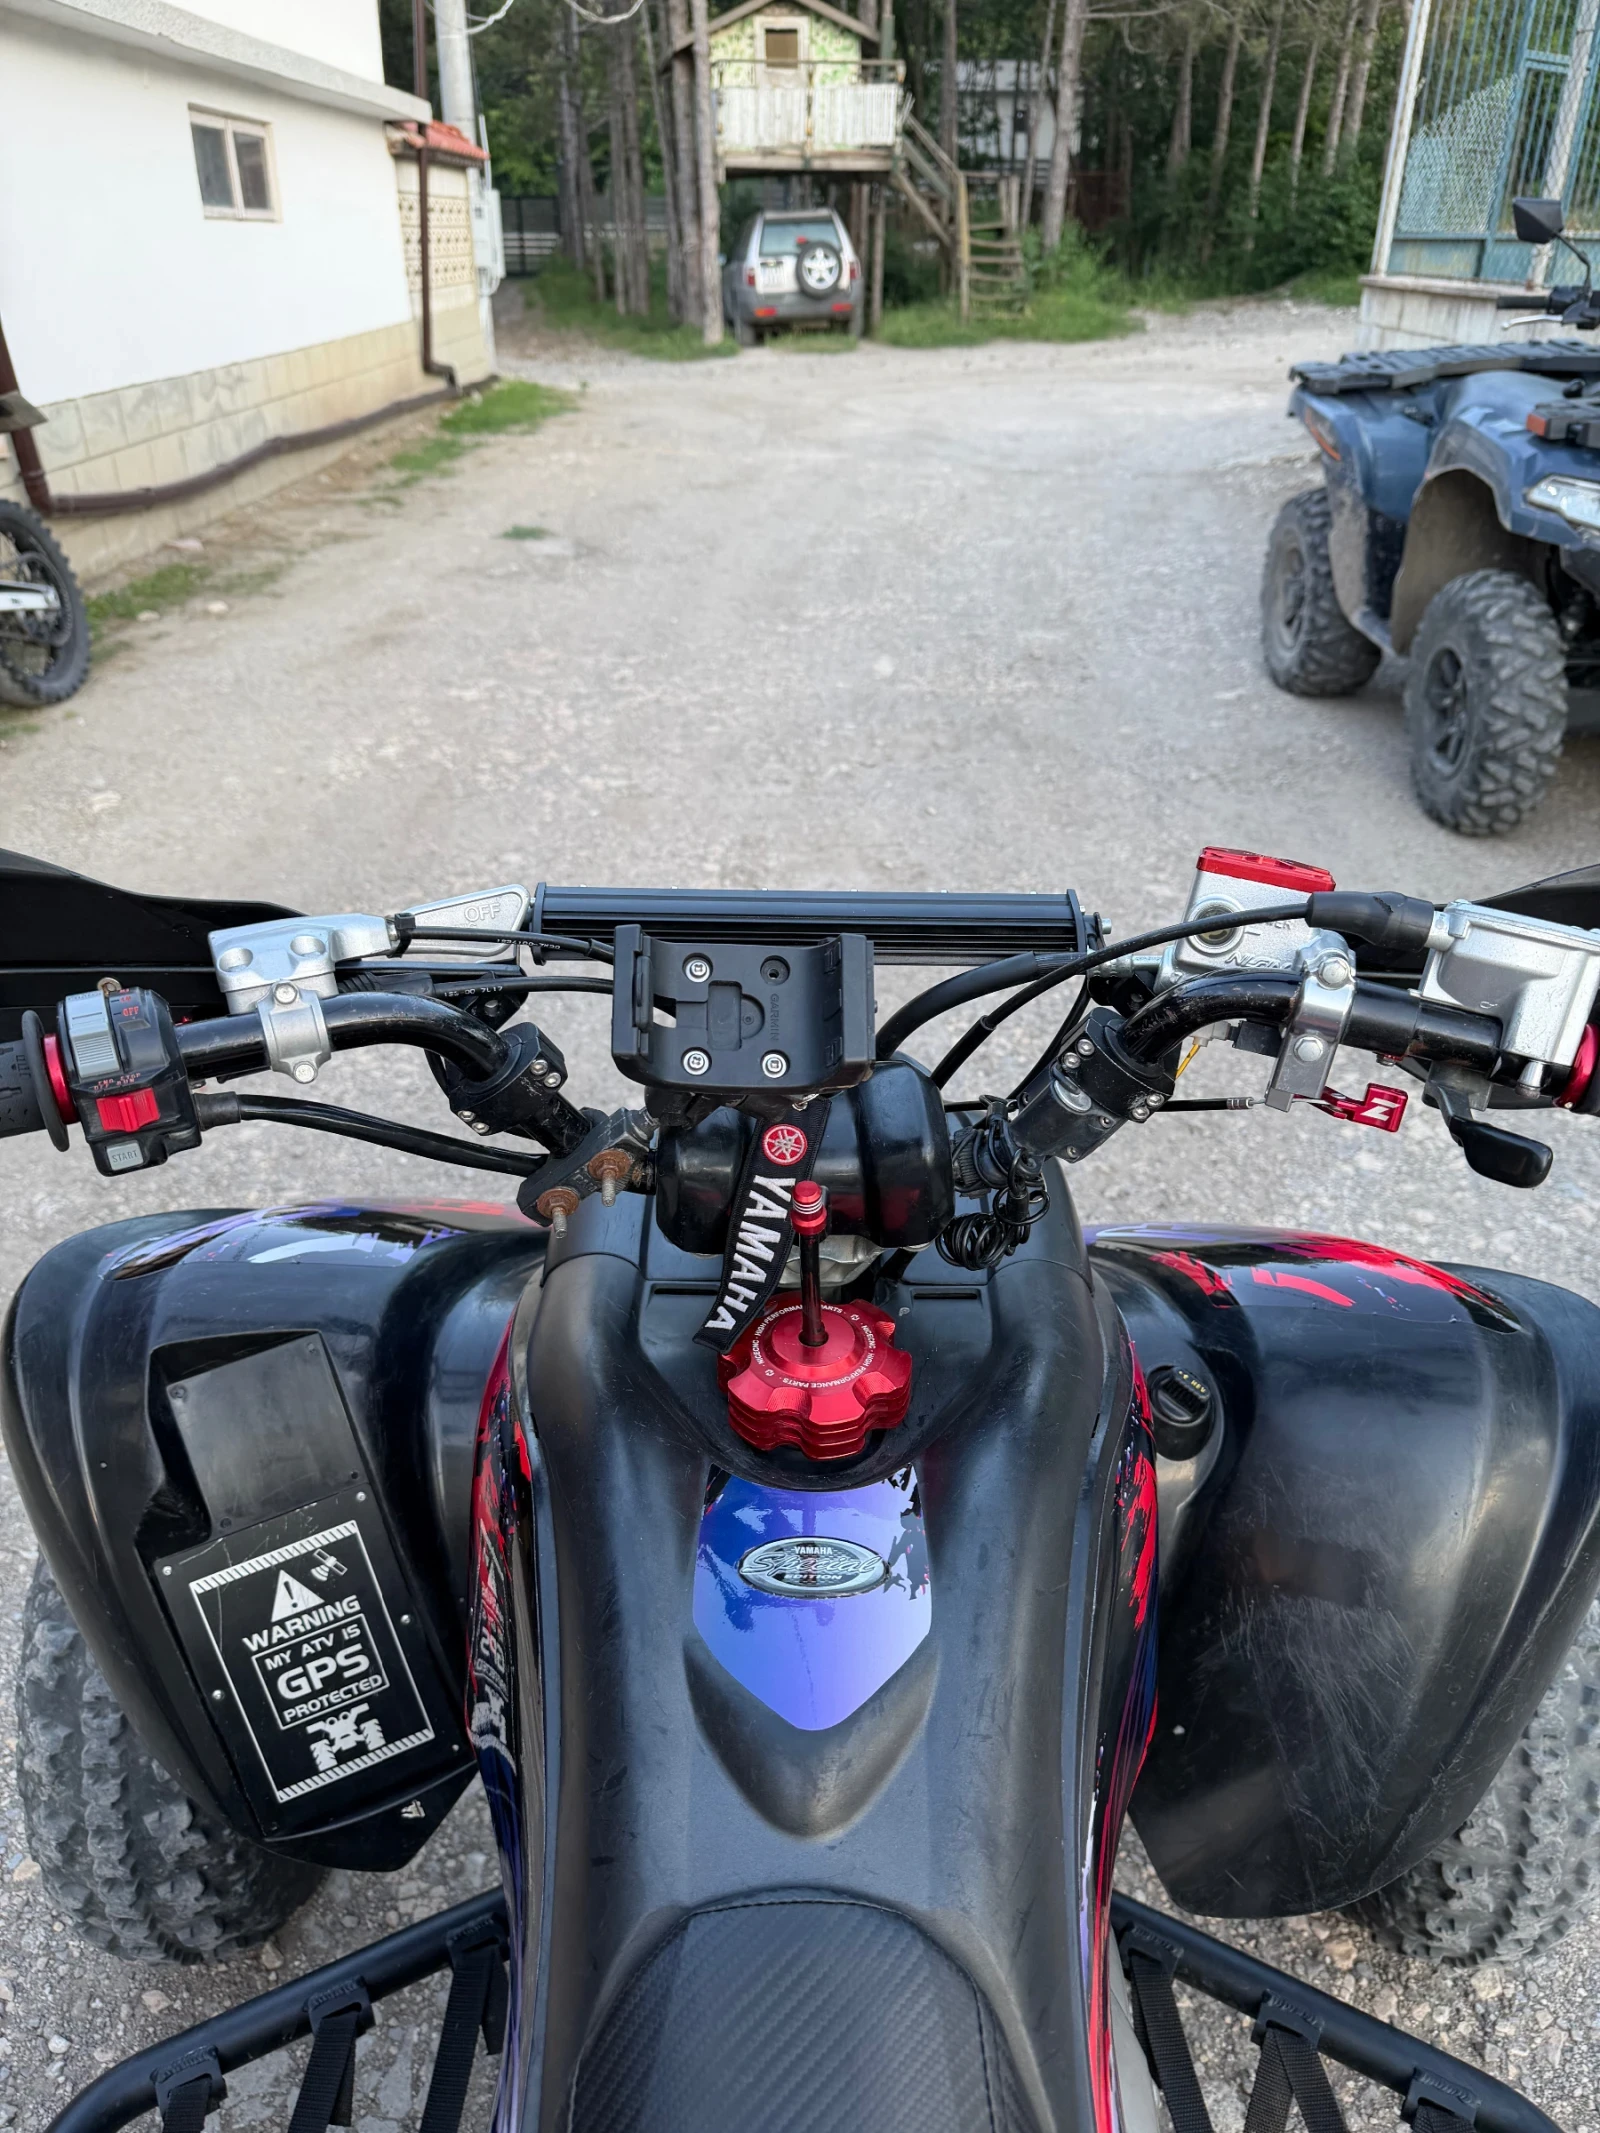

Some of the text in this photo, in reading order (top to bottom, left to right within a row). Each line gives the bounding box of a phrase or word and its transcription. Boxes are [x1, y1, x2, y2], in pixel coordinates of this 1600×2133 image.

[463, 902, 501, 922] OFF
[122, 1006, 139, 1017] OFF
[770, 993, 780, 1041] GARMIN
[111, 1150, 138, 1163] START
[705, 1175, 796, 1331] YAMAHA
[754, 1321, 767, 1336] HIGH
[782, 1377, 809, 1389] PARTS
[811, 1365, 867, 1389] PERFORMANCE
[793, 1546, 834, 1555] YAMAHA
[740, 1551, 883, 1576] Special
[242, 1595, 362, 1652] WARNING
[264, 1623, 361, 1671] MY ATV IS
[276, 1643, 370, 1699] GPS
[282, 1674, 383, 1723] PROTECTED
